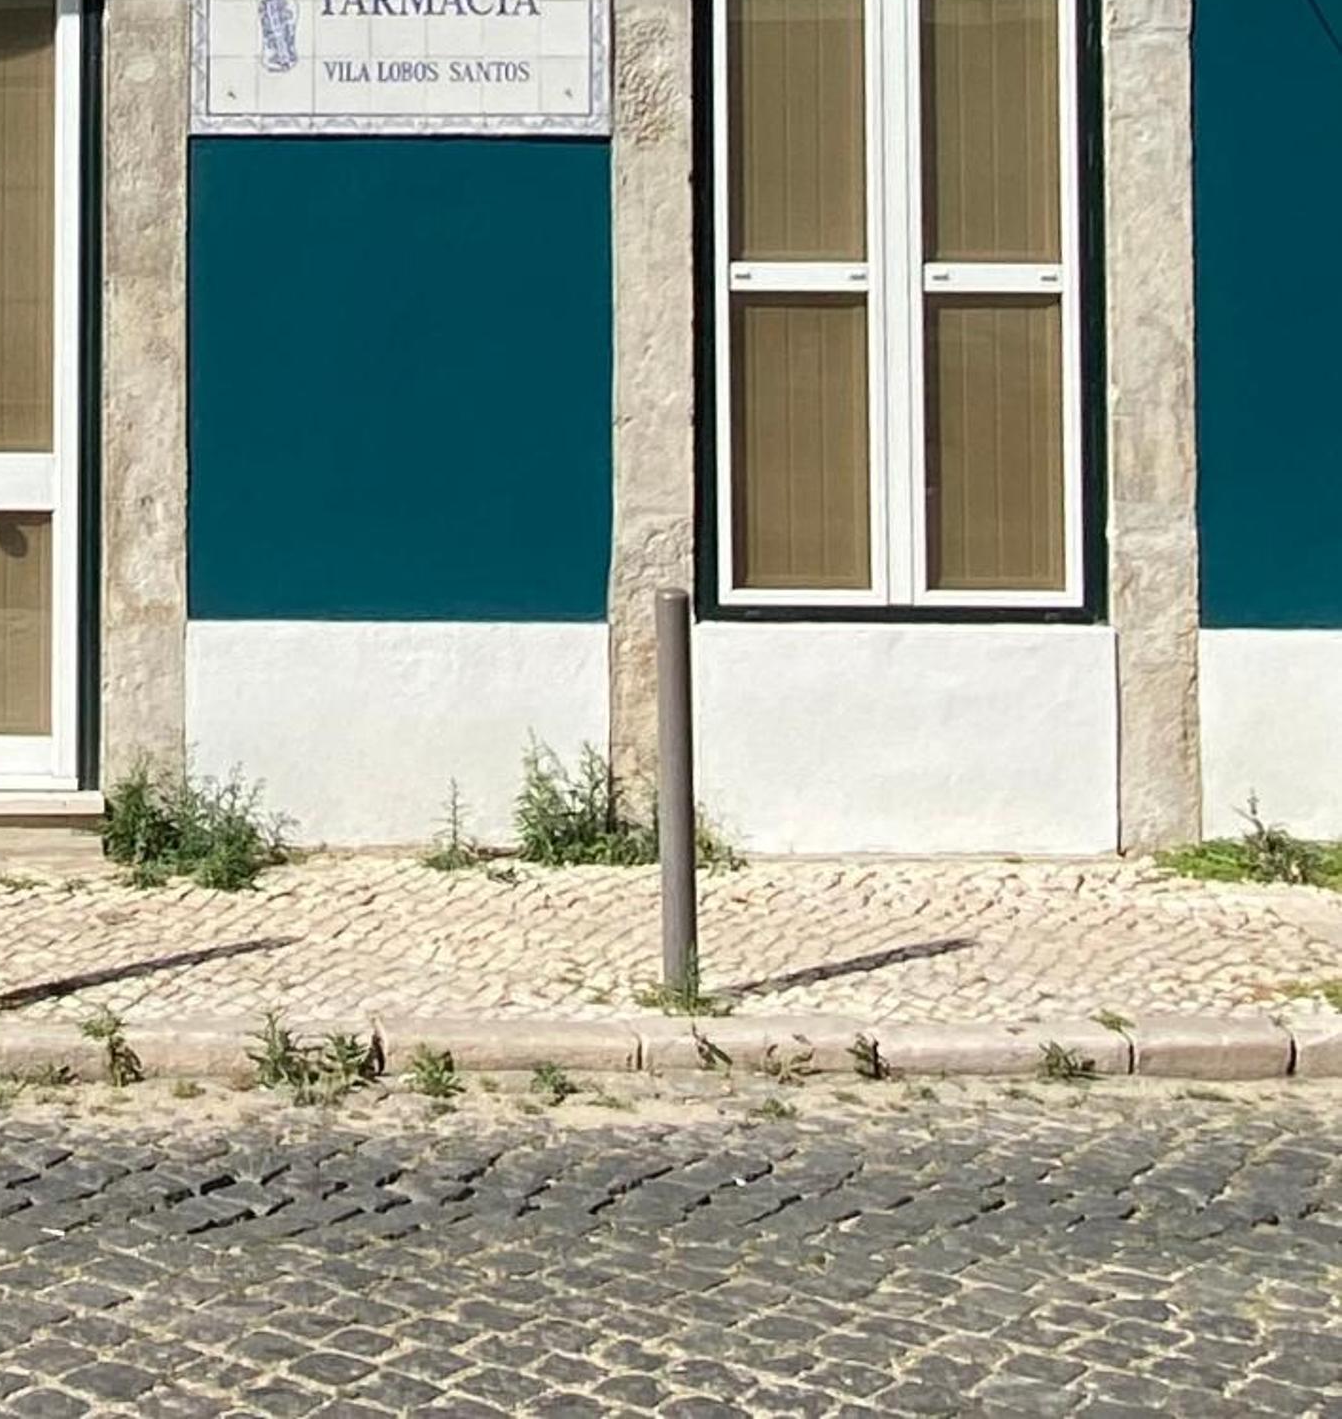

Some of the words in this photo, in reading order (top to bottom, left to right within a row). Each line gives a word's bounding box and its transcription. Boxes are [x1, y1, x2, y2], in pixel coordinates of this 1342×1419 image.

[323, 61, 371, 82] VILA
[377, 61, 439, 82] LOBOS
[449, 61, 531, 82] SANTOS
